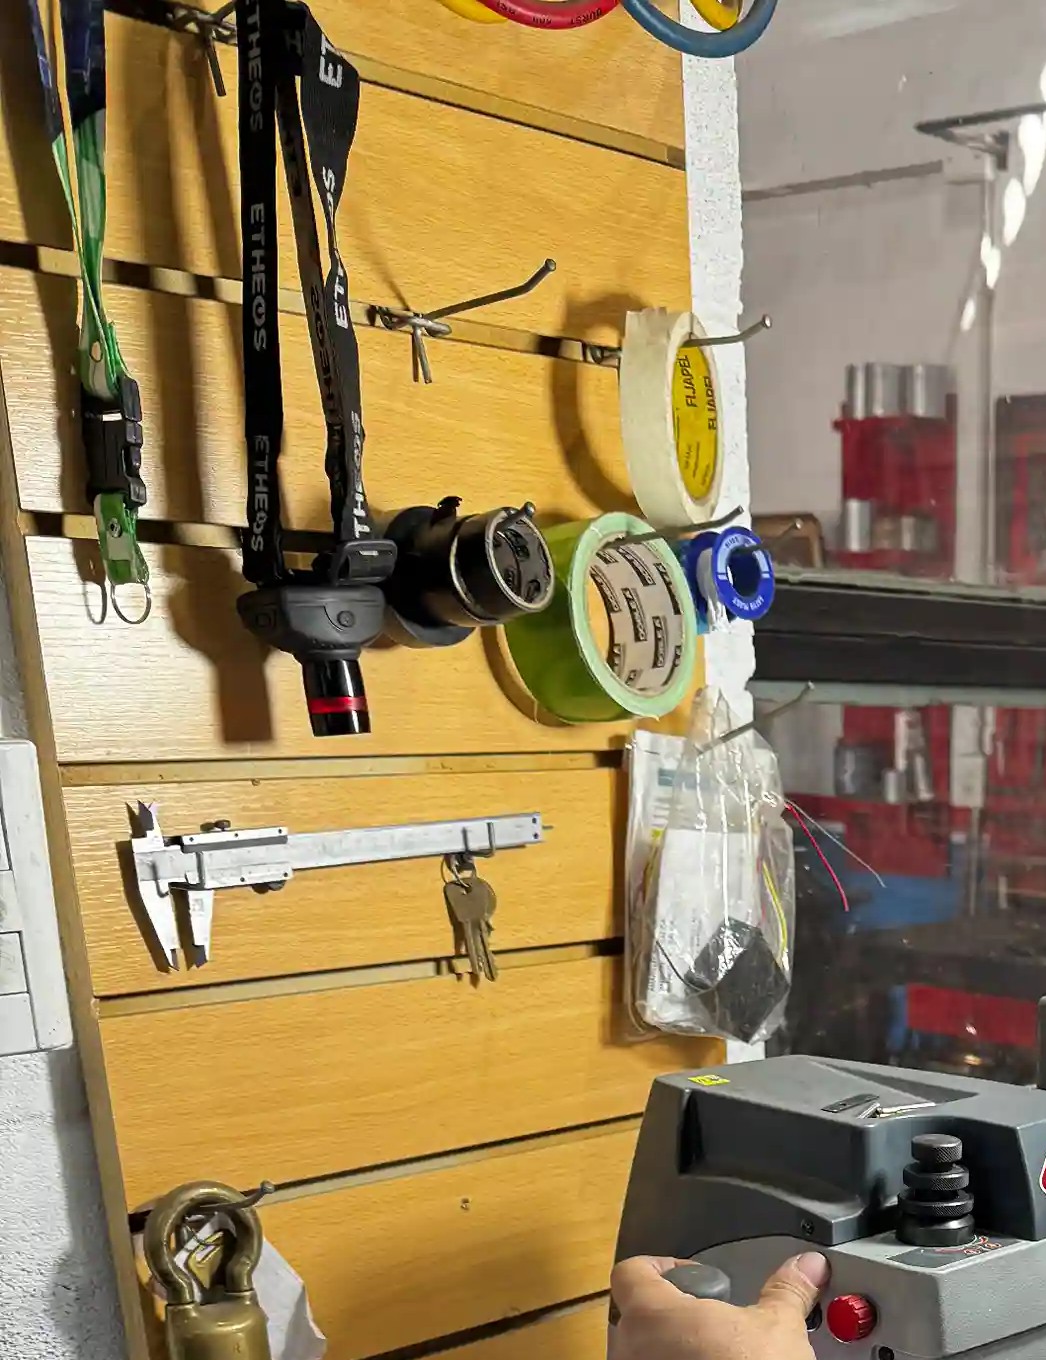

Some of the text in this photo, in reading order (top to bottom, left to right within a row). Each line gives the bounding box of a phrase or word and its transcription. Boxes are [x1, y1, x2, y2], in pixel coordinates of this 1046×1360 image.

[246, 0, 263, 132] THEOS
[250, 202, 267, 352] ETHEOS
[679, 354, 698, 408] FIJAPEL
[251, 434, 269, 552] ETHEOS
